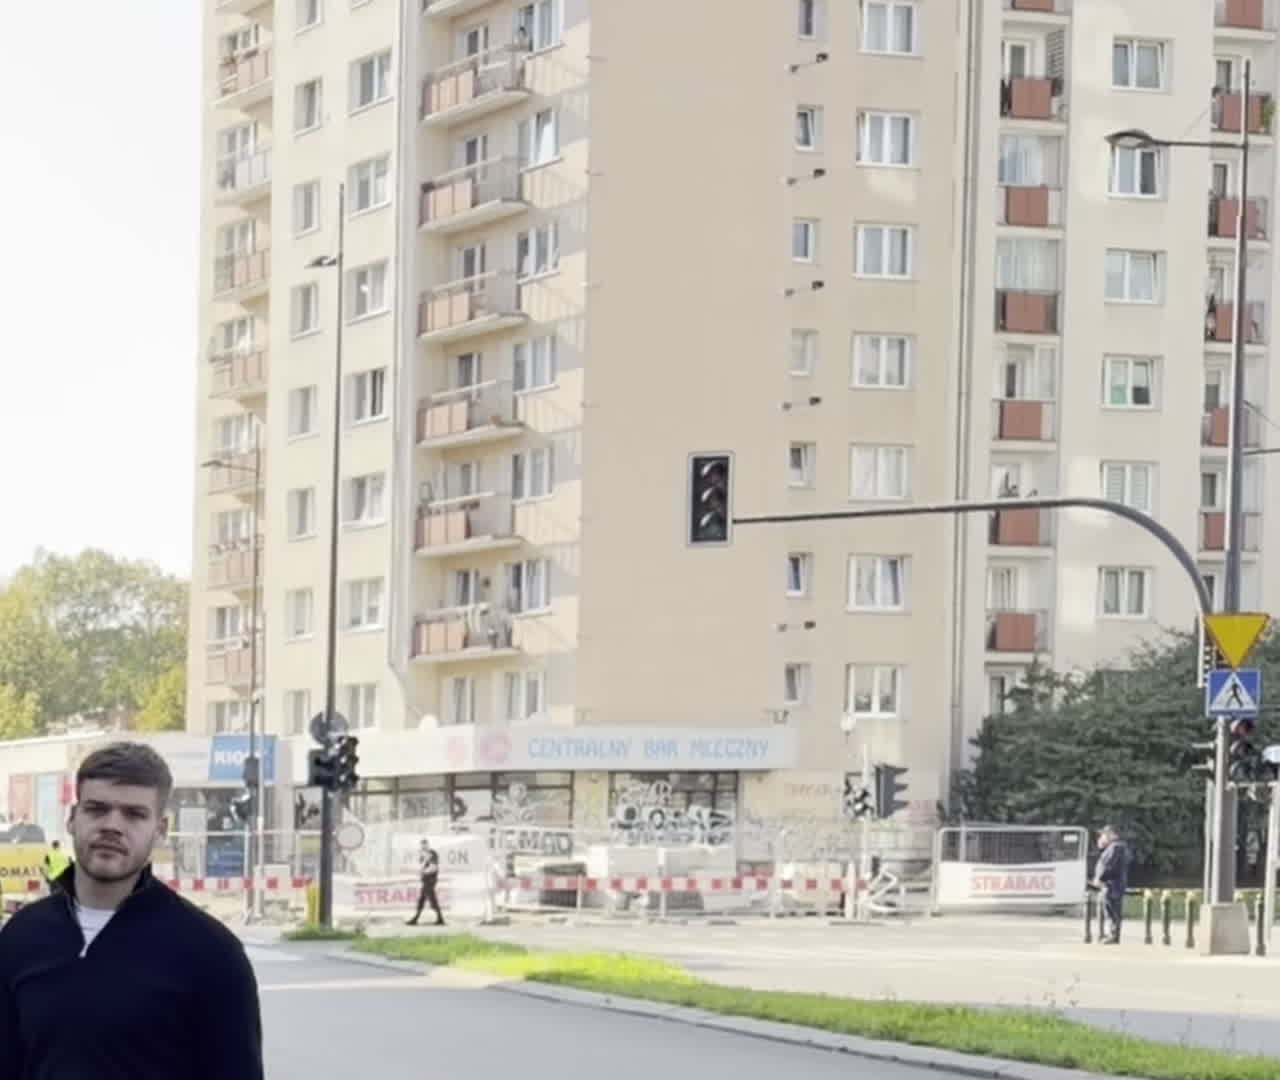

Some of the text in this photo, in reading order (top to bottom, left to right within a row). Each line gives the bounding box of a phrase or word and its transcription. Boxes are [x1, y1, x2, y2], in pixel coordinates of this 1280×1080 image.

[527, 735, 769, 760] CENTRALNY BAR MLECZNY
[214, 750, 266, 768] KIO
[970, 873, 1056, 891] STRABAG
